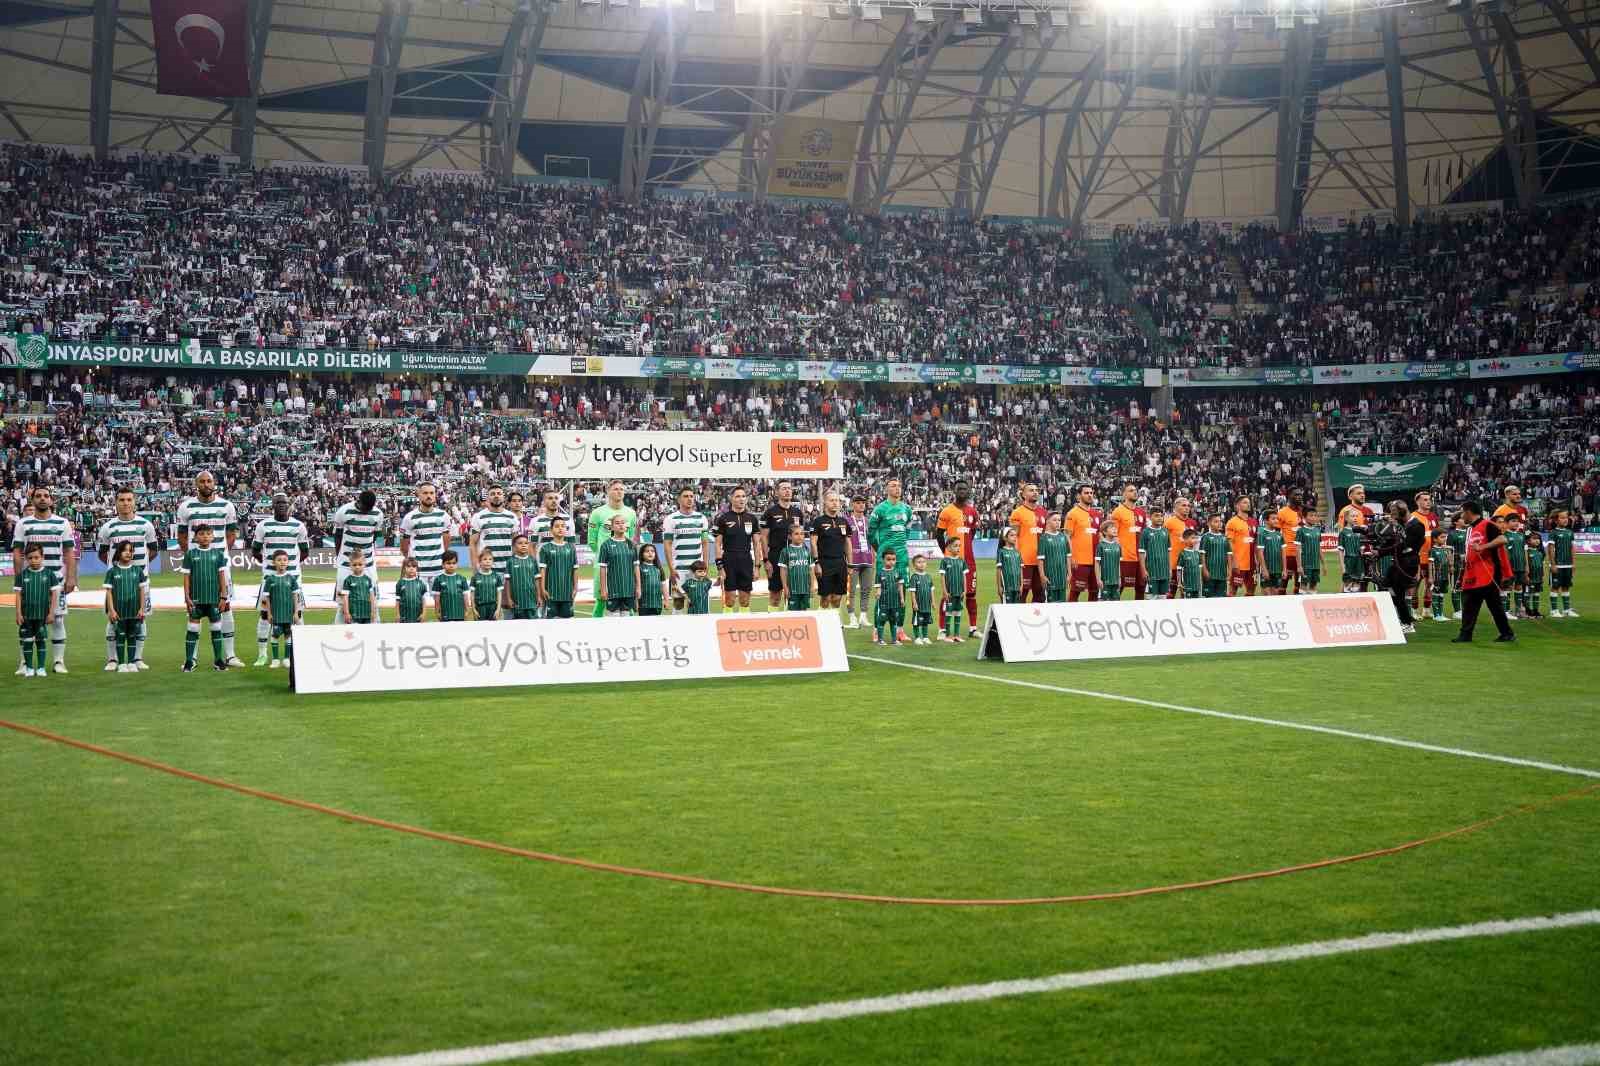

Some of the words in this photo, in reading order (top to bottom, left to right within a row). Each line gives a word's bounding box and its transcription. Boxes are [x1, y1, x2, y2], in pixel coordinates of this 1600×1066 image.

[220, 351, 319, 368] BAŞARILAR
[461, 355, 488, 365] ALTAY
[592, 443, 684, 467] trendyol
[689, 447, 763, 469] SüperLig
[777, 443, 823, 457] trendyol
[783, 455, 818, 467] yemek
[727, 624, 811, 645] trendyol
[1058, 613, 1184, 645] trendyol
[1188, 616, 1288, 644] SüperLig
[1327, 622, 1371, 639] yemek
[376, 635, 547, 673] trendyol
[557, 637, 690, 672] SüperLig
[742, 644, 803, 665] yemek
